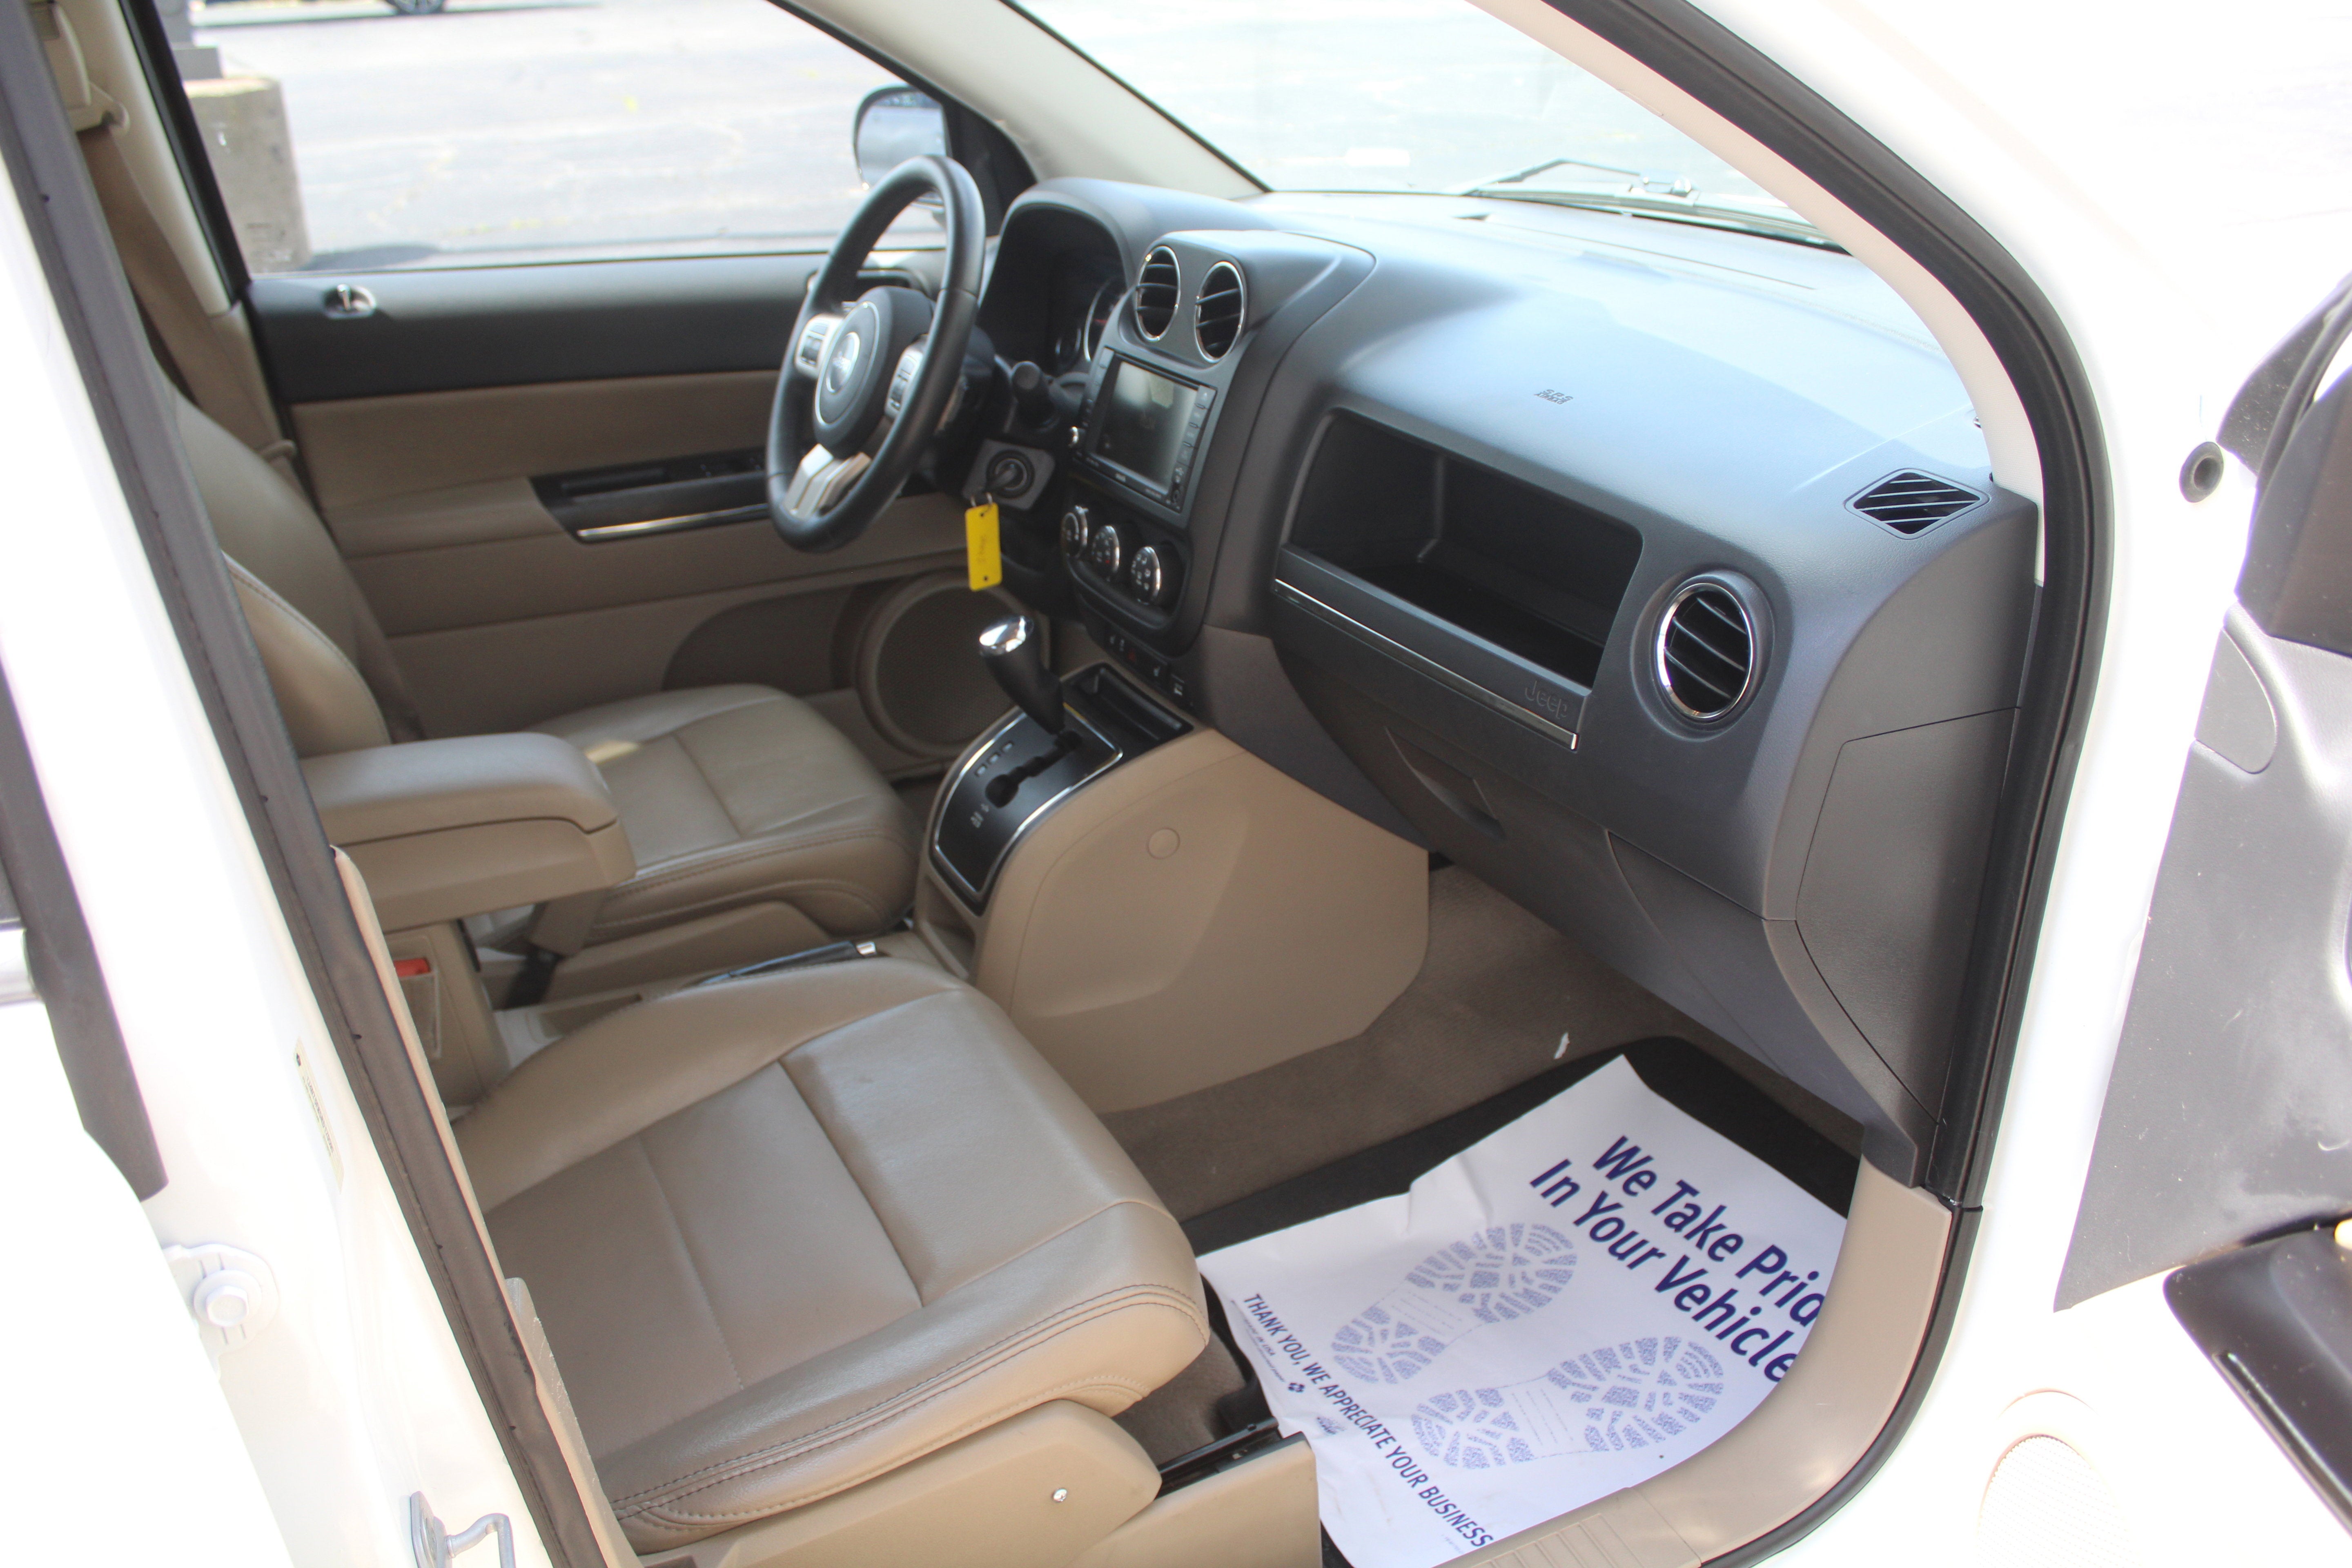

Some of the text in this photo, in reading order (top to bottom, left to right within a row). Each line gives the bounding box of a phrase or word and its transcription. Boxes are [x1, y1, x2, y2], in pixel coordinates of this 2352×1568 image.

[1525, 680, 1568, 719] Jeep
[1529, 1158, 1798, 1383] In Your Vehicle
[1592, 1135, 1657, 1197] We
[1650, 1179, 1744, 1262] Take
[1244, 1293, 1288, 1336] THANK
[1278, 1334, 1311, 1365] YOU,
[1302, 1362, 1331, 1384] WE
[1319, 1384, 1396, 1449] APPRECIATE
[1385, 1445, 1429, 1488] YOUR
[1418, 1486, 1494, 1546] BUSINESS
